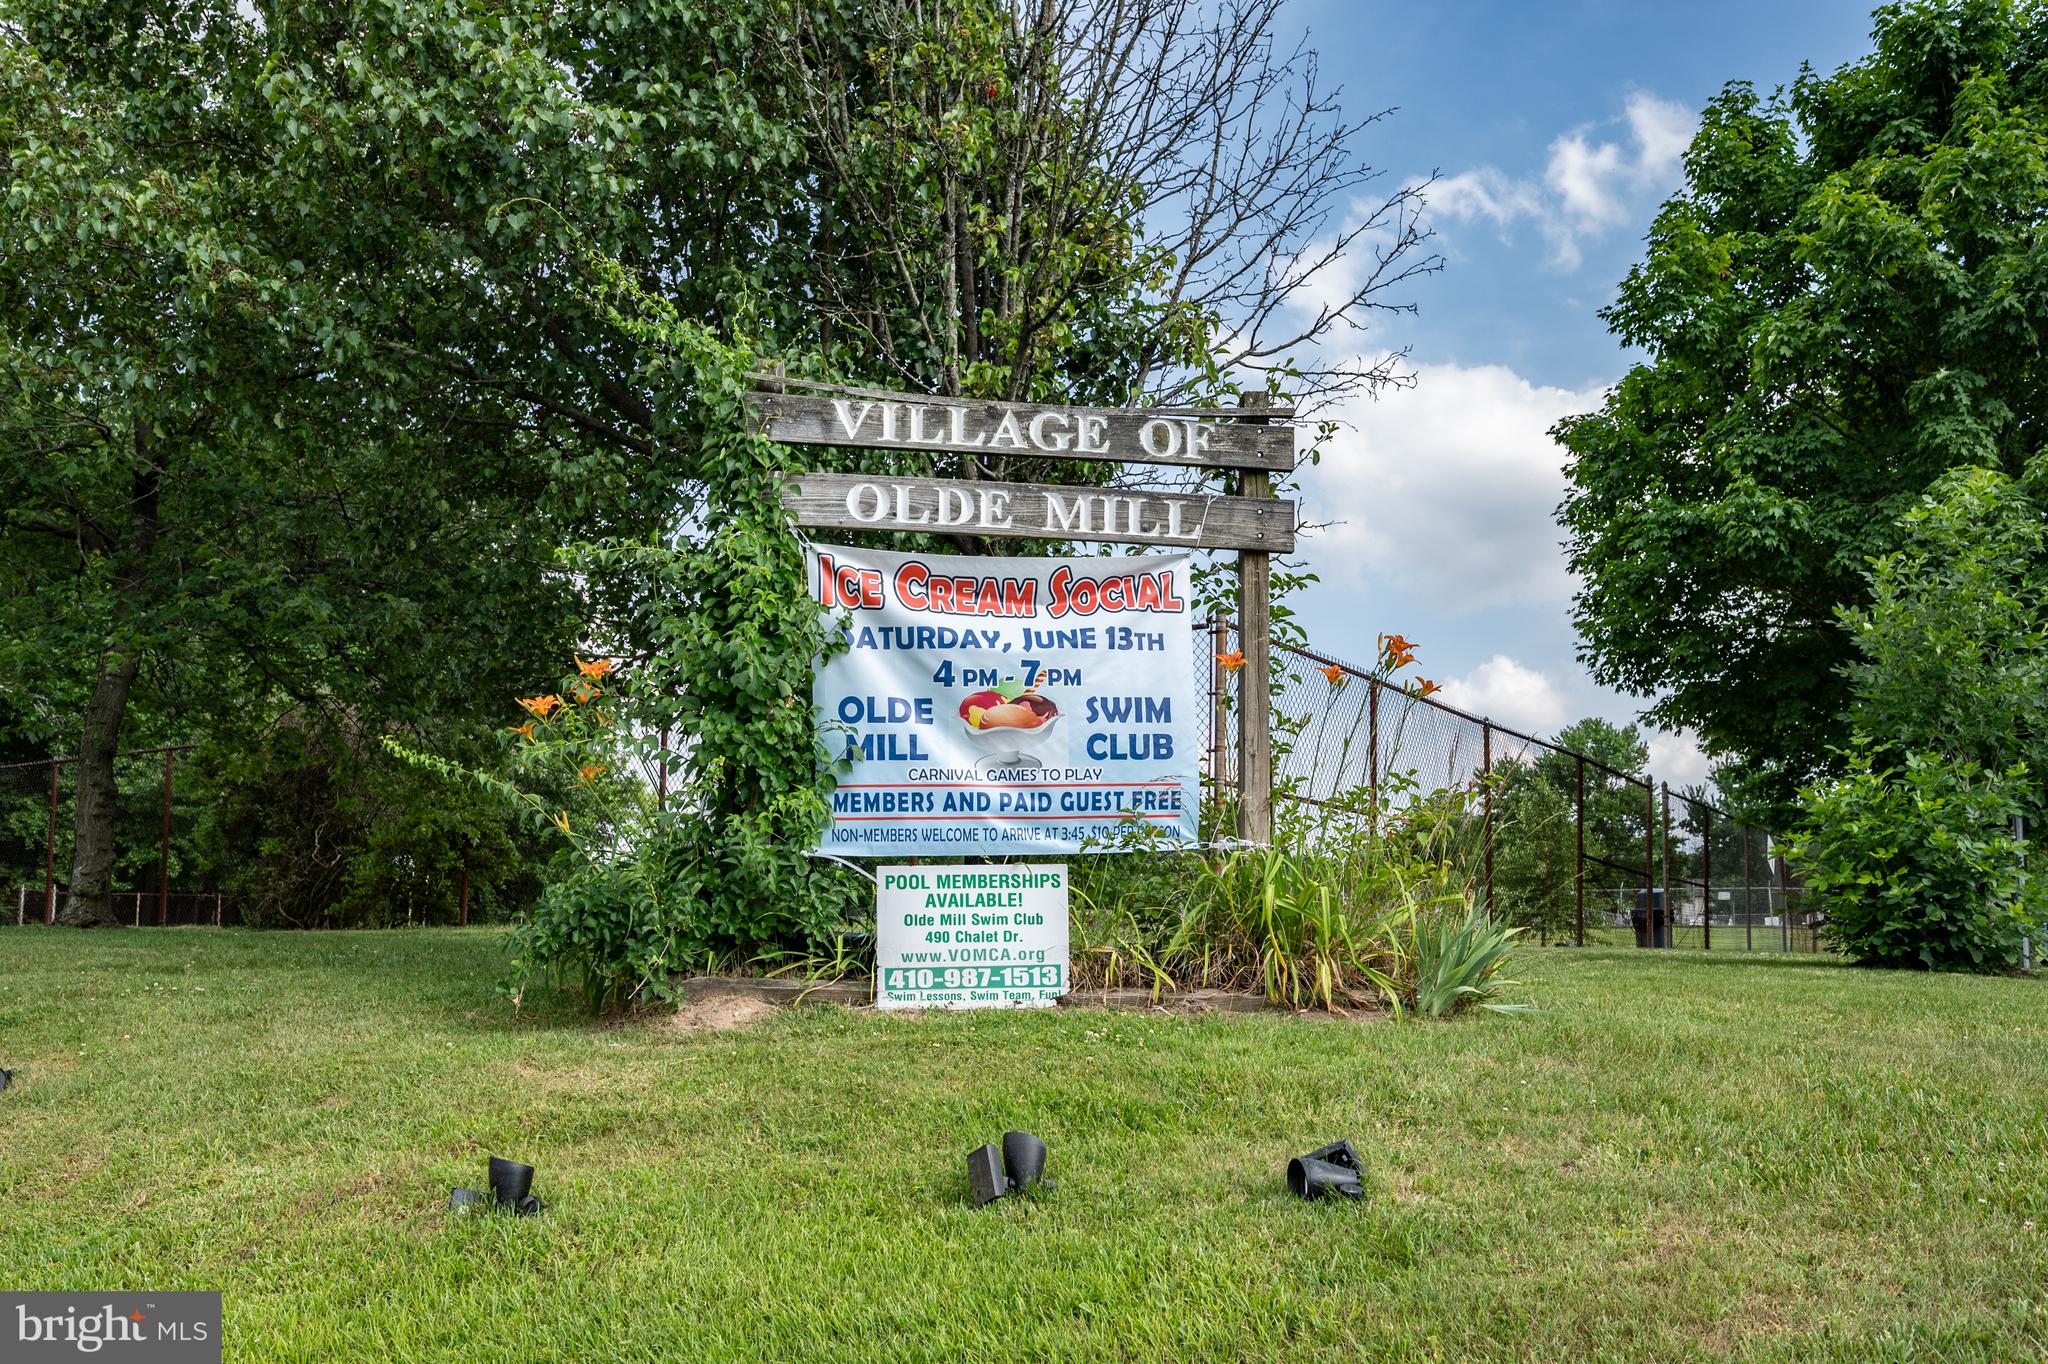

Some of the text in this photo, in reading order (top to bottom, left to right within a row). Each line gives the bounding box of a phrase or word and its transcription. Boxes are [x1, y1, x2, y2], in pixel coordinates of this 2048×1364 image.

[830, 399, 1218, 459] VILLAGE OF
[845, 483, 1202, 539] OLDE MILL
[816, 552, 1185, 619] ICE CREAM SOCIAL
[1022, 626, 1097, 653] JUNE
[1105, 625, 1165, 651] 13TH
[933, 659, 956, 687] 4
[962, 668, 998, 687] PM
[1020, 659, 1041, 687] 7
[1047, 668, 1082, 686] PM
[838, 695, 934, 725] OLDE
[1086, 696, 1172, 724] SWIM
[846, 733, 929, 761] MILL
[1086, 733, 1174, 761] CLUB
[908, 768, 1103, 782] CARNIVAL GAMES TO PLAY
[833, 790, 1182, 812] MEMBERS AND PAID GUEST FREE
[831, 828, 918, 843] NON-MEMBERS
[921, 827, 979, 842] WELCOME
[982, 827, 998, 842] TO
[1001, 827, 1041, 841] ARRIVE
[1044, 826, 1059, 841] AT
[885, 873, 1061, 890] POOL MEMBERSHIPS
[925, 892, 1024, 908] AVAILABLE!
[903, 912, 1044, 926] Olde Mill Swim Club
[925, 930, 1023, 943] 490 Chalet Dr.
[901, 948, 1046, 963] www.VOMCA.org
[888, 966, 1058, 989] 410-987-1513
[887, 991, 916, 1001] Swim
[970, 990, 999, 1001] Swim
